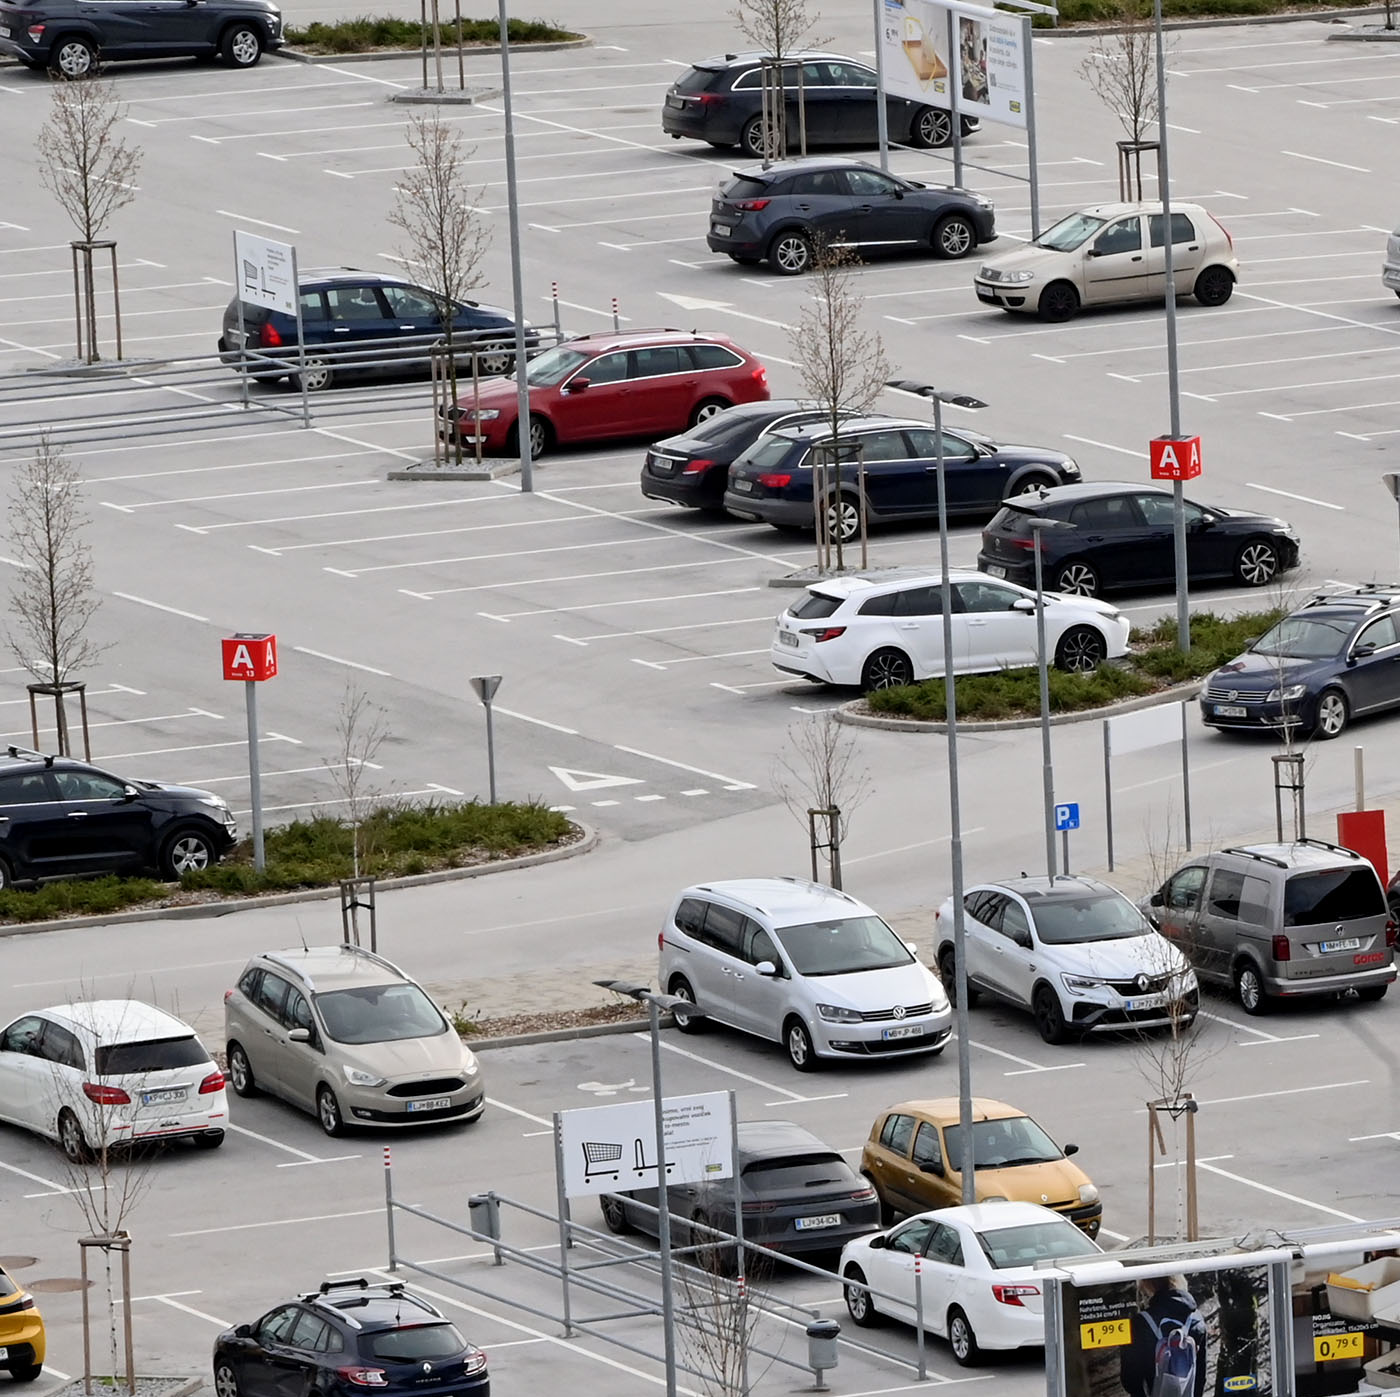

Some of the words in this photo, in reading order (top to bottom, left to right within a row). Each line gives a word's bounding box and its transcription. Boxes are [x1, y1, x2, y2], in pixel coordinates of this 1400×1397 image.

[1159, 445, 1180, 468] A
[1190, 442, 1199, 467] A
[232, 644, 254, 669] A
[266, 642, 274, 667] A
[1057, 806, 1069, 826] P
[1087, 1324, 1115, 1344] 1,99
[1118, 1323, 1124, 1332] €
[1320, 1339, 1348, 1358] 0,79
[1352, 1337, 1358, 1346] €
